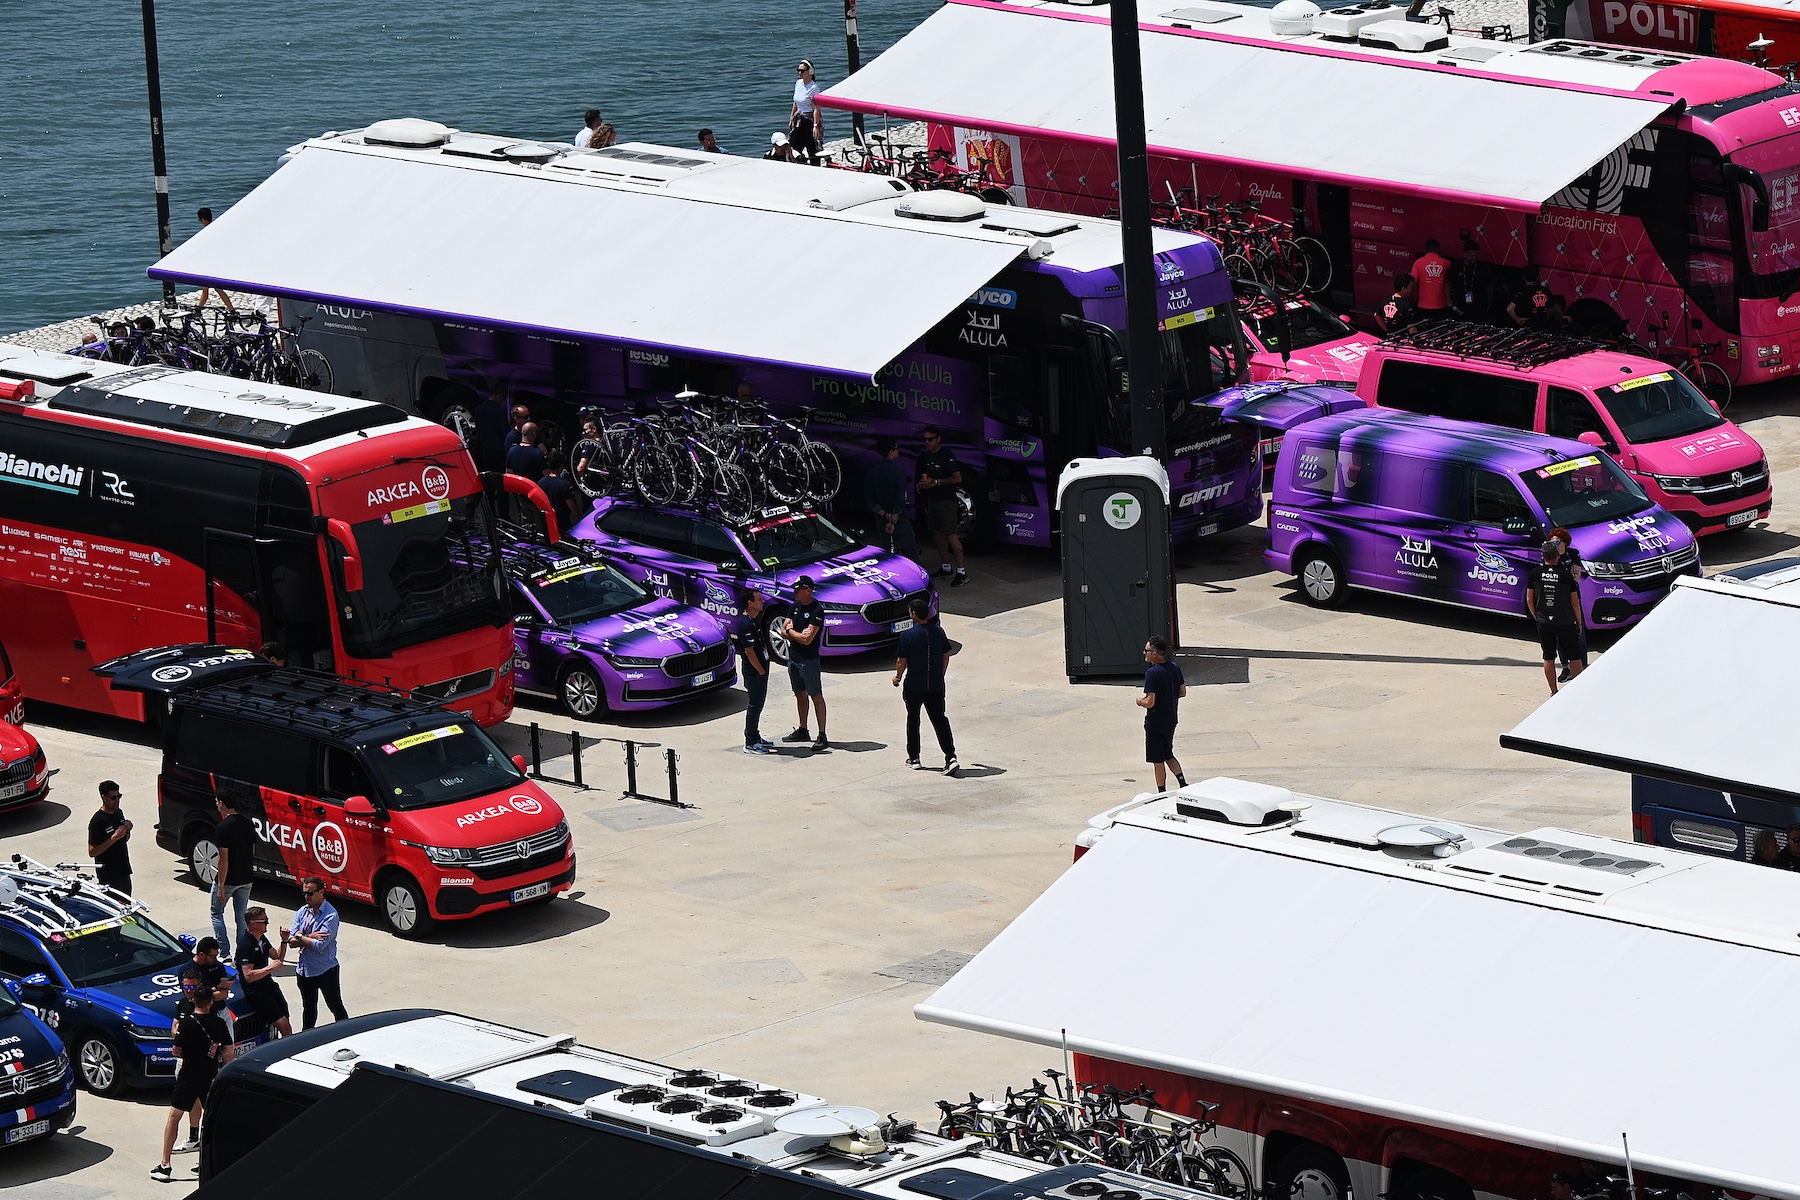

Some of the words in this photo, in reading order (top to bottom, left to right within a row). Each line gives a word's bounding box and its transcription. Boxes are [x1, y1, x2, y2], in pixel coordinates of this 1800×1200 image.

[1603, 1, 1696, 44] POLTI
[1535, 212, 1593, 232] Education
[1592, 219, 1618, 236] First
[1159, 269, 1185, 282] Jayco
[1166, 297, 1193, 312] ALULA
[957, 327, 1009, 348] ALULA
[426, 473, 447, 490] B&B
[367, 479, 421, 508] ARKEA
[1178, 480, 1235, 508] GIANT
[764, 506, 788, 517] Jayco
[1274, 508, 1300, 520] GIANT
[1606, 514, 1656, 536] Jayco
[1637, 533, 1676, 553] ALULA
[555, 557, 580, 569] Jayco
[820, 557, 879, 580] Jayco
[1393, 550, 1439, 570] ALULA
[1467, 565, 1519, 587] Jayco
[700, 597, 739, 618] Jayco
[622, 611, 679, 634] Jayco
[656, 625, 702, 643] ALULA
[514, 798, 537, 810] B&B
[455, 803, 513, 829] ARKEA
[316, 836, 344, 857] B&B
[320, 851, 341, 864] HOTELS
[439, 876, 475, 886] Bianchi
